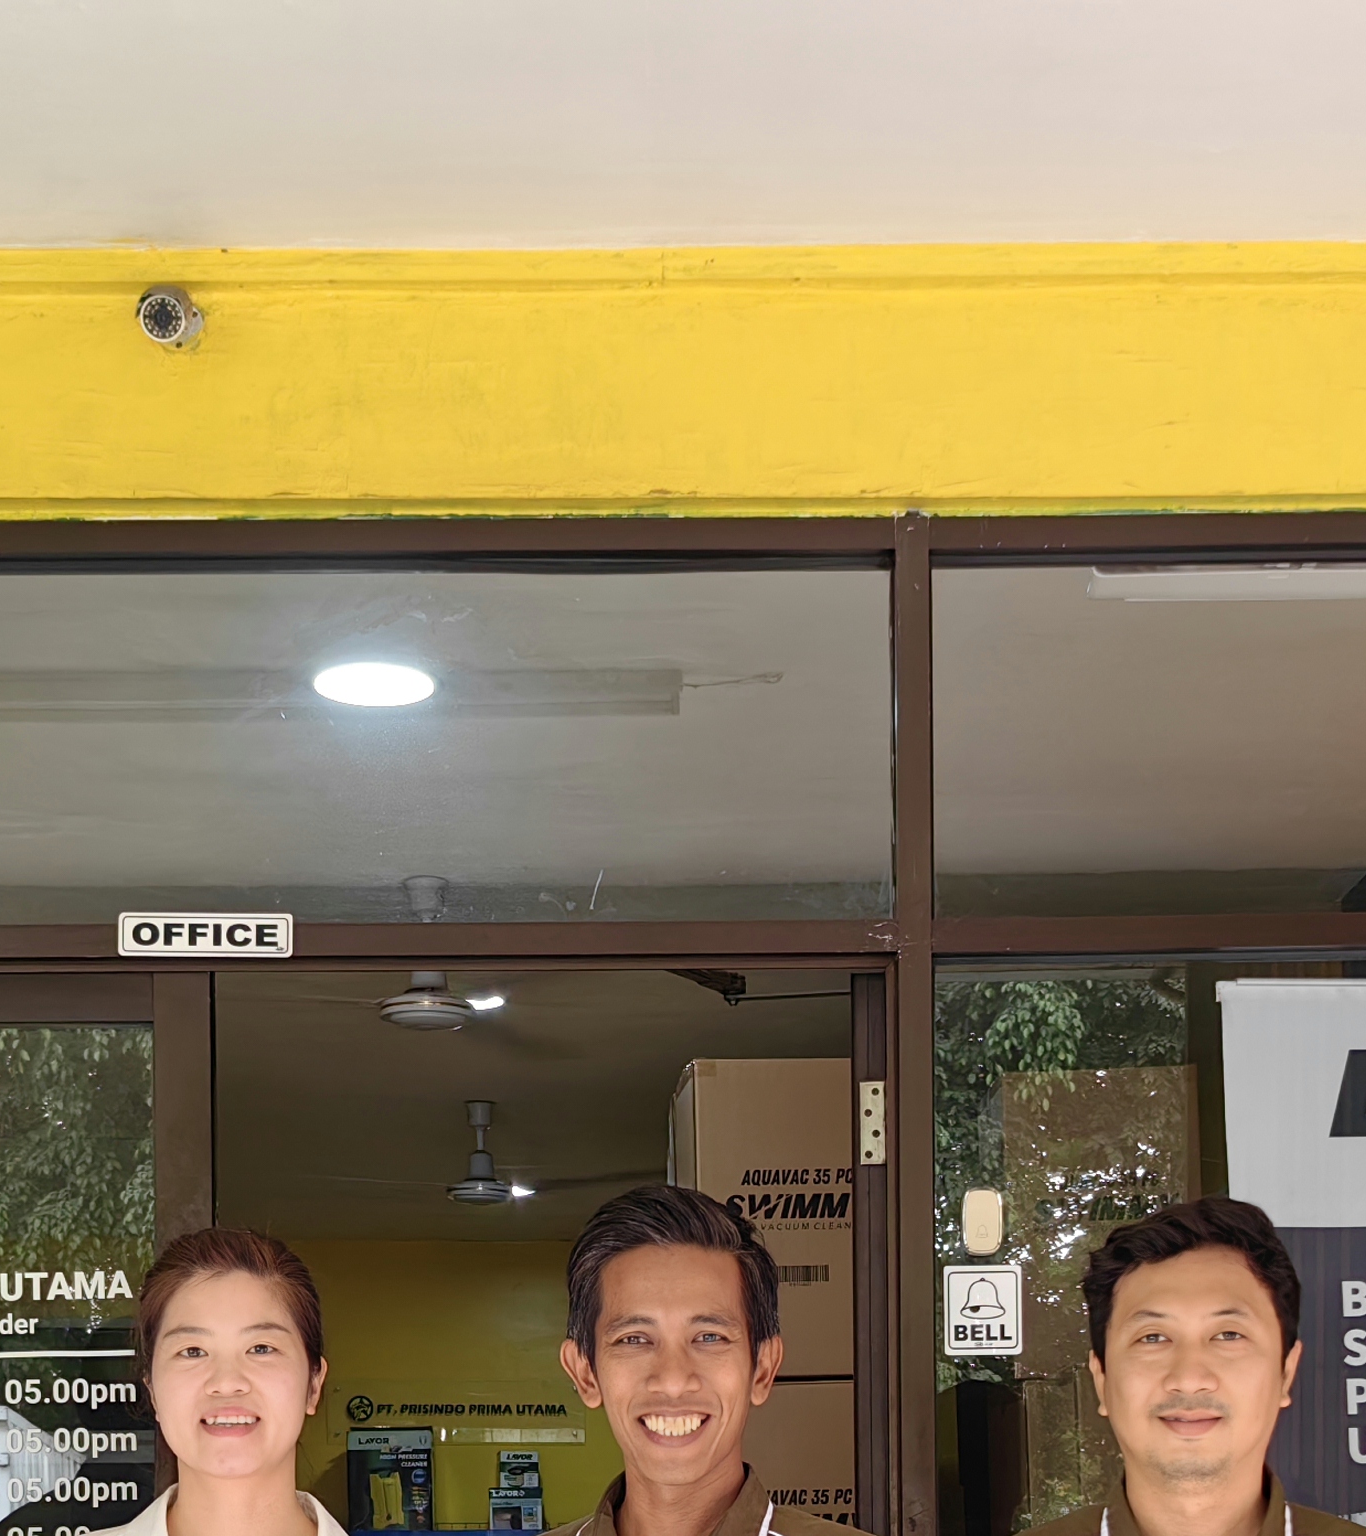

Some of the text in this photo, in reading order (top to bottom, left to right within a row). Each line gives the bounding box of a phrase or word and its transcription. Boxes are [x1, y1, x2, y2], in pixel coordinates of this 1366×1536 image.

[132, 922, 278, 947] OFFICE
[741, 1169, 810, 1186] AQUAVAC
[813, 1168, 831, 1185] 35
[726, 1192, 851, 1219] SWIMM
[761, 1222, 810, 1231] VACUUM
[0, 1270, 134, 1300] UTAMA
[954, 1324, 1012, 1341] BELL
[5, 1379, 136, 1409] 05.00pm
[400, 1404, 466, 1416] PRISINDO
[469, 1404, 513, 1416] PRIMA
[516, 1404, 567, 1417] UTAMA
[6, 1427, 138, 1458] 05.00pm
[7, 1476, 138, 1508] 05.00pm
[811, 1489, 830, 1505] 35
[834, 1488, 853, 1504] PC
